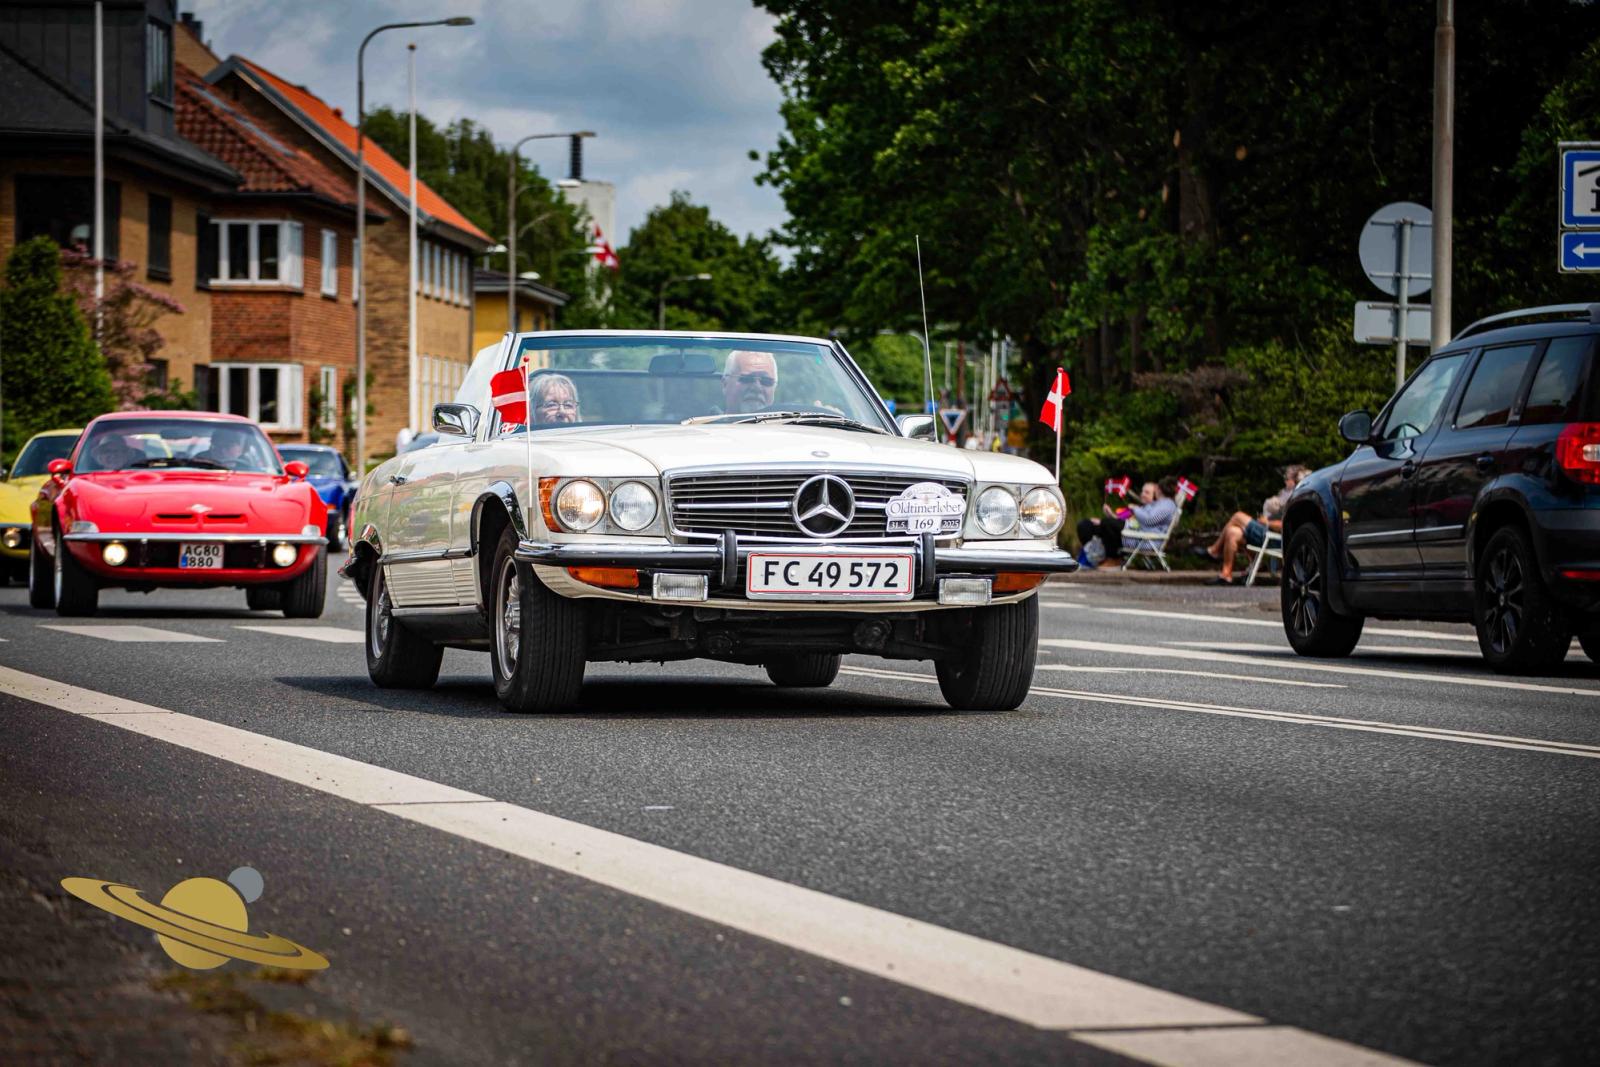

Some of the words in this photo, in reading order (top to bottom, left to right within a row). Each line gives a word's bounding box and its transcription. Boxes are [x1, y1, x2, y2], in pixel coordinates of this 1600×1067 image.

[914, 519, 934, 530] 169
[942, 520, 960, 529] 2025
[189, 556, 214, 567] 880
[764, 561, 800, 586] FC
[808, 562, 841, 588] 49
[849, 562, 899, 588] 572
